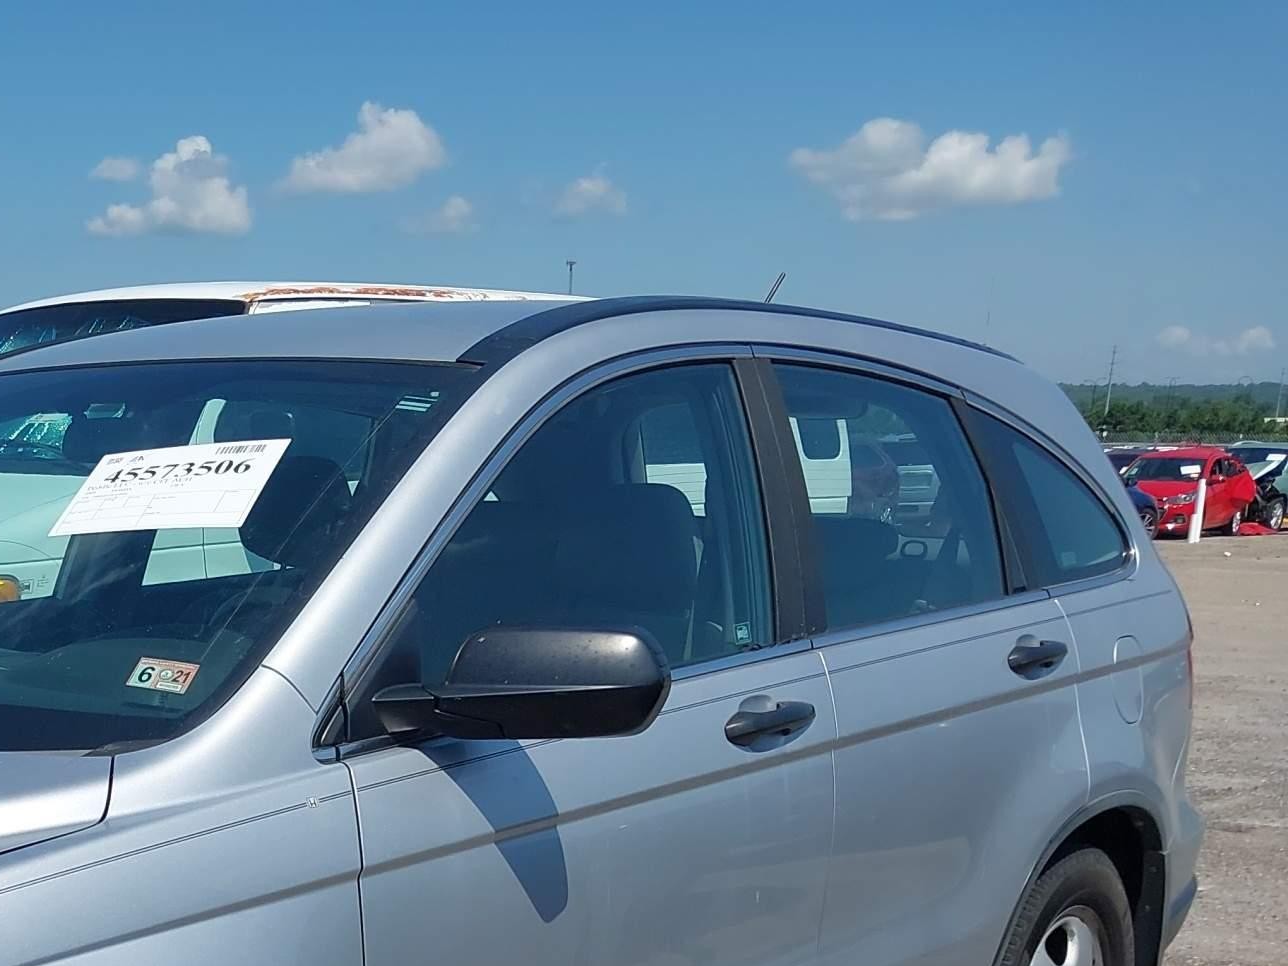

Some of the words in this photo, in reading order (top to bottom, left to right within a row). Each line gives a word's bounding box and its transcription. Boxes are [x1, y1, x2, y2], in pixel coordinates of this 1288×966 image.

[105, 458, 254, 483] 45573506
[137, 666, 156, 683] 6
[171, 669, 192, 684] 21
